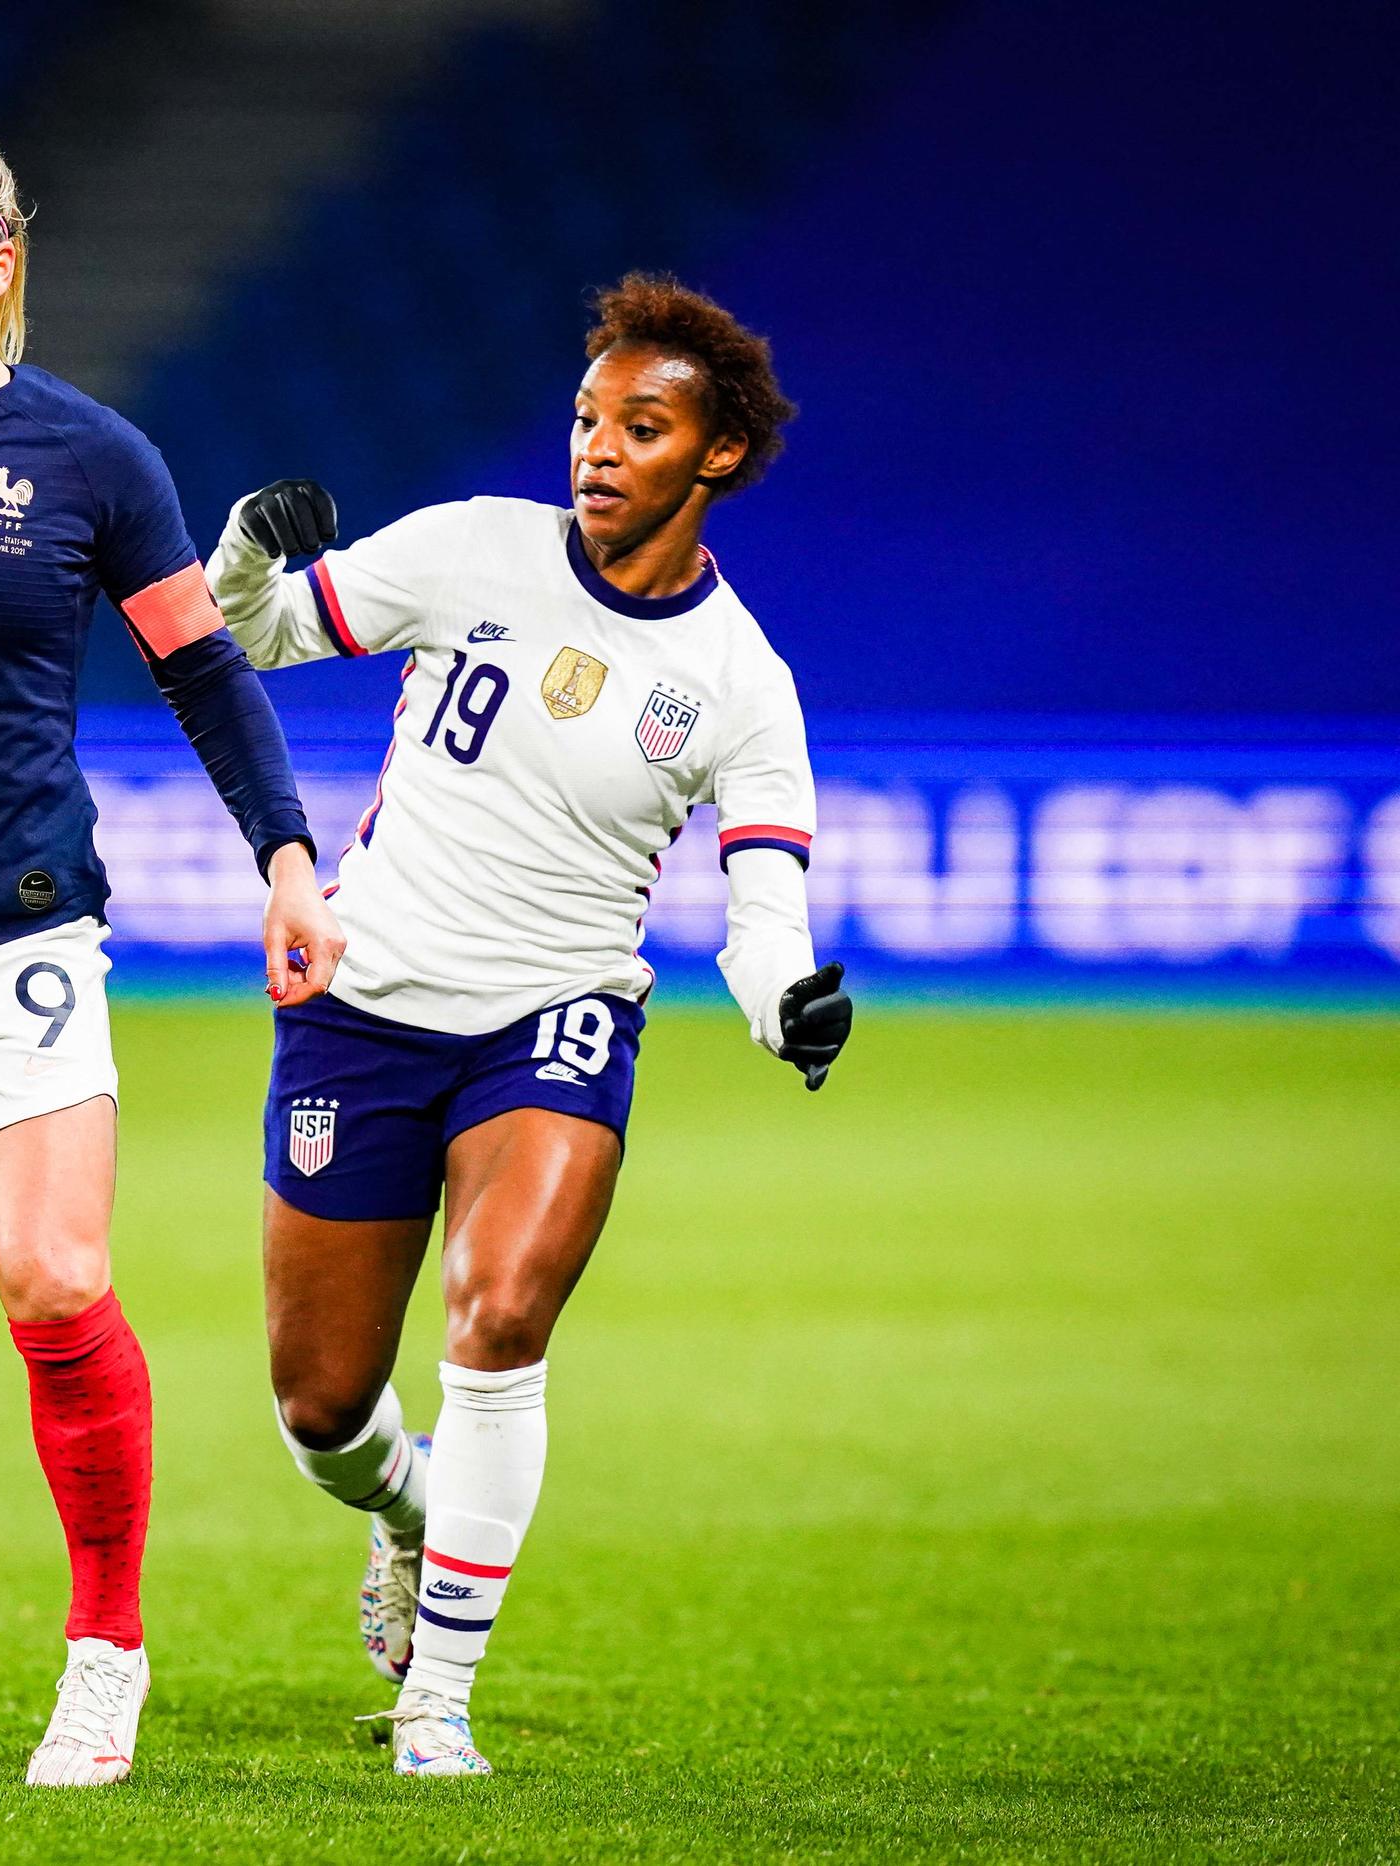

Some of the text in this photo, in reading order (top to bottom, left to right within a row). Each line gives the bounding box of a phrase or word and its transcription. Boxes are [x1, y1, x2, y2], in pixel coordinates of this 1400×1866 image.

[10, 546, 25, 555] 2021
[475, 620, 510, 640] NIKE
[421, 648, 510, 765] 19
[552, 689, 577, 708] FIFA
[651, 697, 692, 728] USA
[15, 961, 76, 1049] 9
[531, 998, 616, 1075] 19
[294, 1114, 332, 1139] USA
[433, 1580, 475, 1598] NIKE
